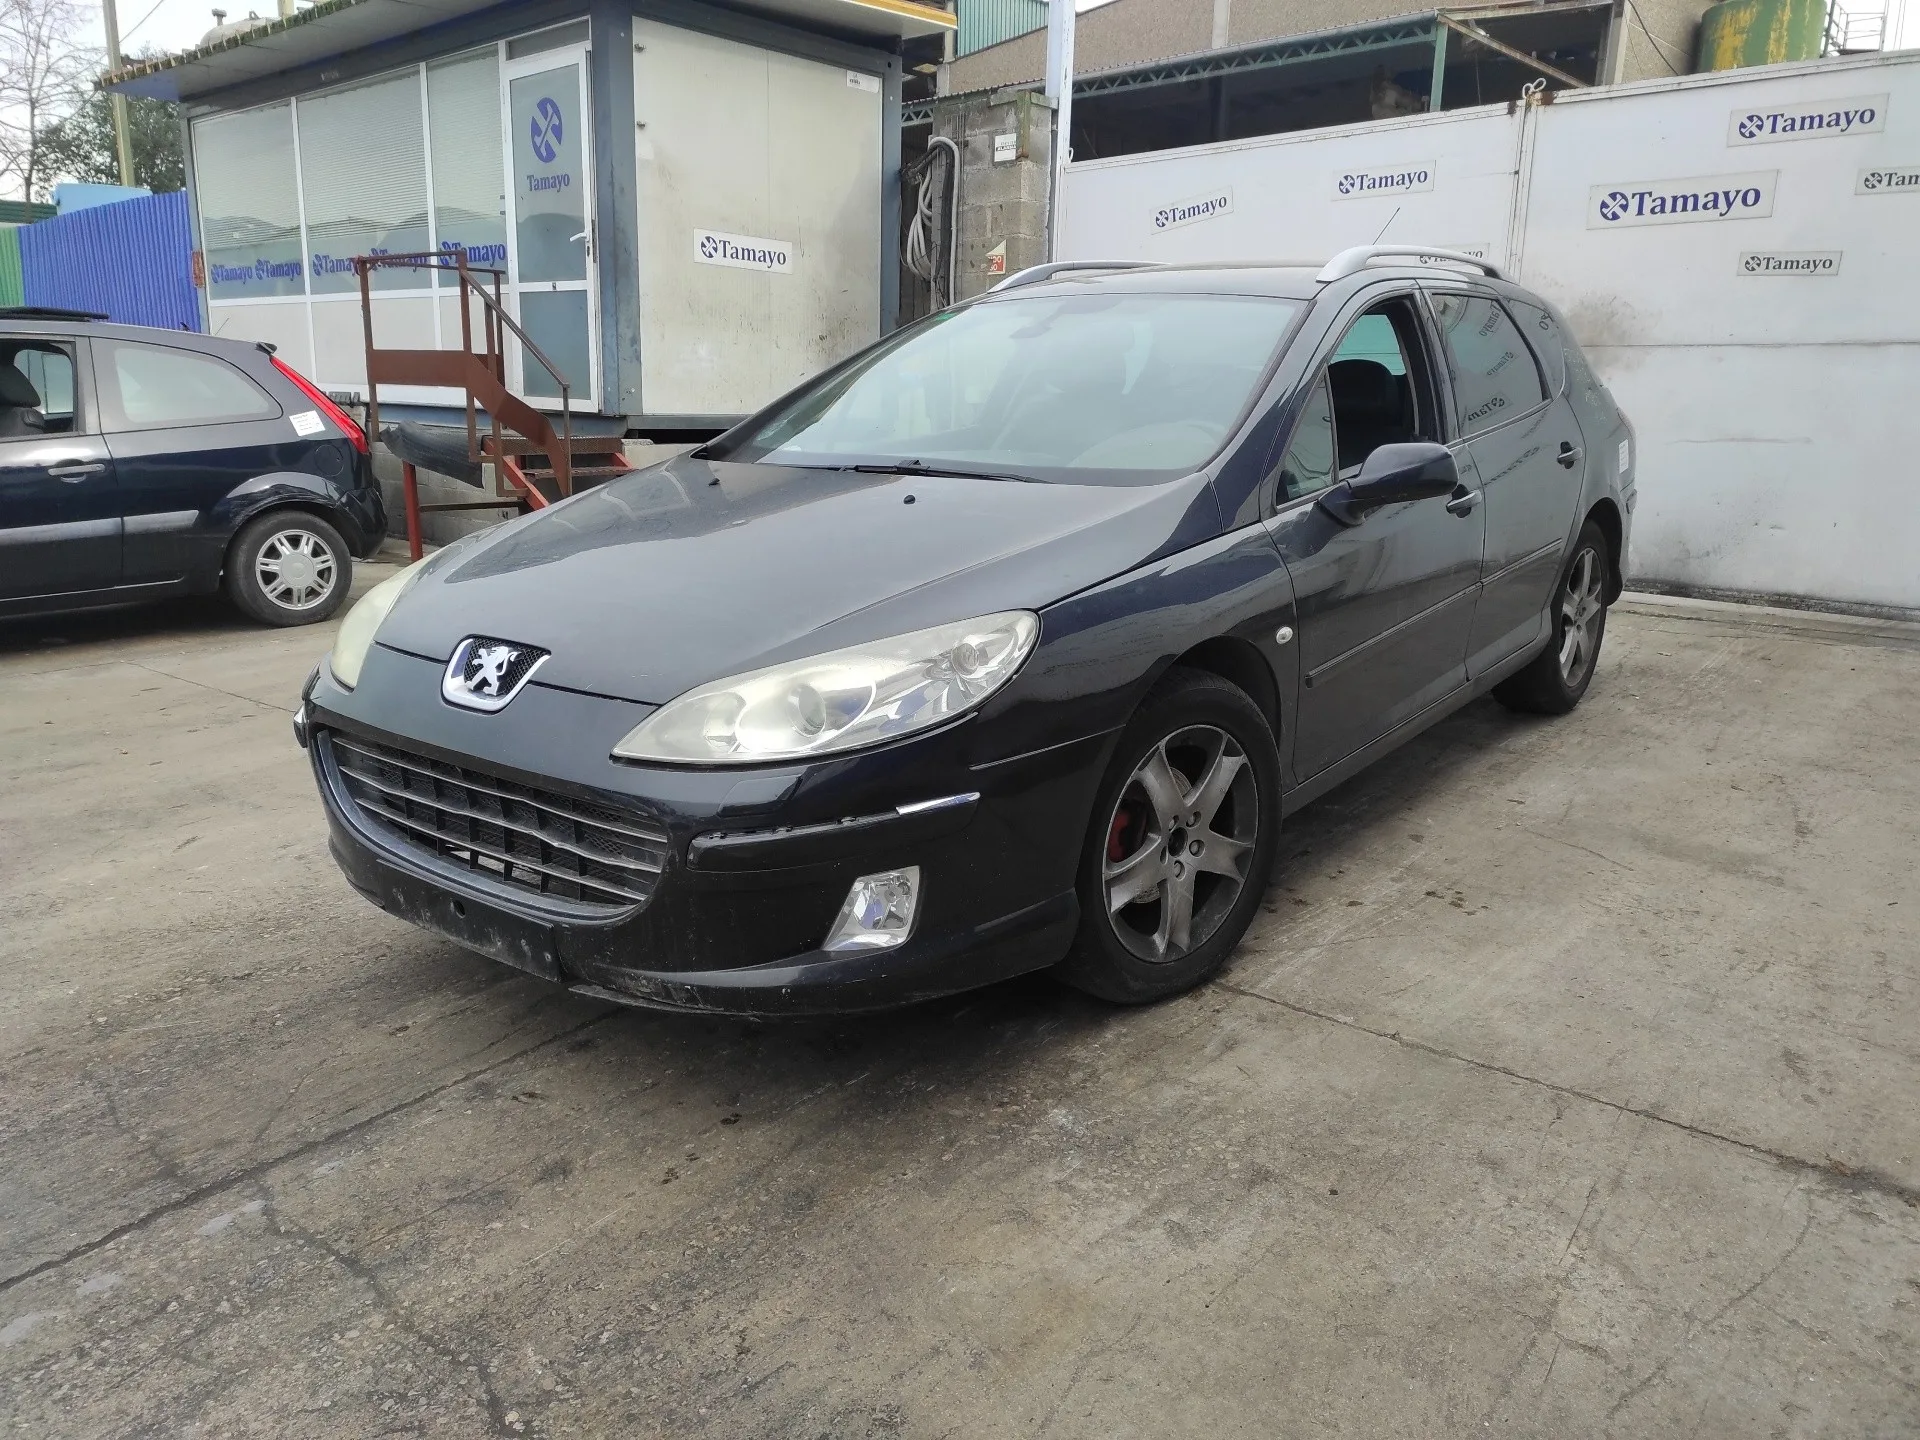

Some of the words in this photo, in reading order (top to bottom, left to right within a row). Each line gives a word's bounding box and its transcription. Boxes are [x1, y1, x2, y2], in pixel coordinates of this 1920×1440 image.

[1766, 107, 1876, 134] Tamayo
[527, 173, 571, 193] Tamayo
[1356, 169, 1428, 191] Tamayo
[1169, 195, 1228, 224] Tamayo
[1631, 187, 1761, 217] Tamayo
[718, 239, 787, 269] Tamayo
[1762, 255, 1833, 273] Tamayo
[218, 264, 254, 285] Tamayo
[264, 260, 302, 281] Tamayo
